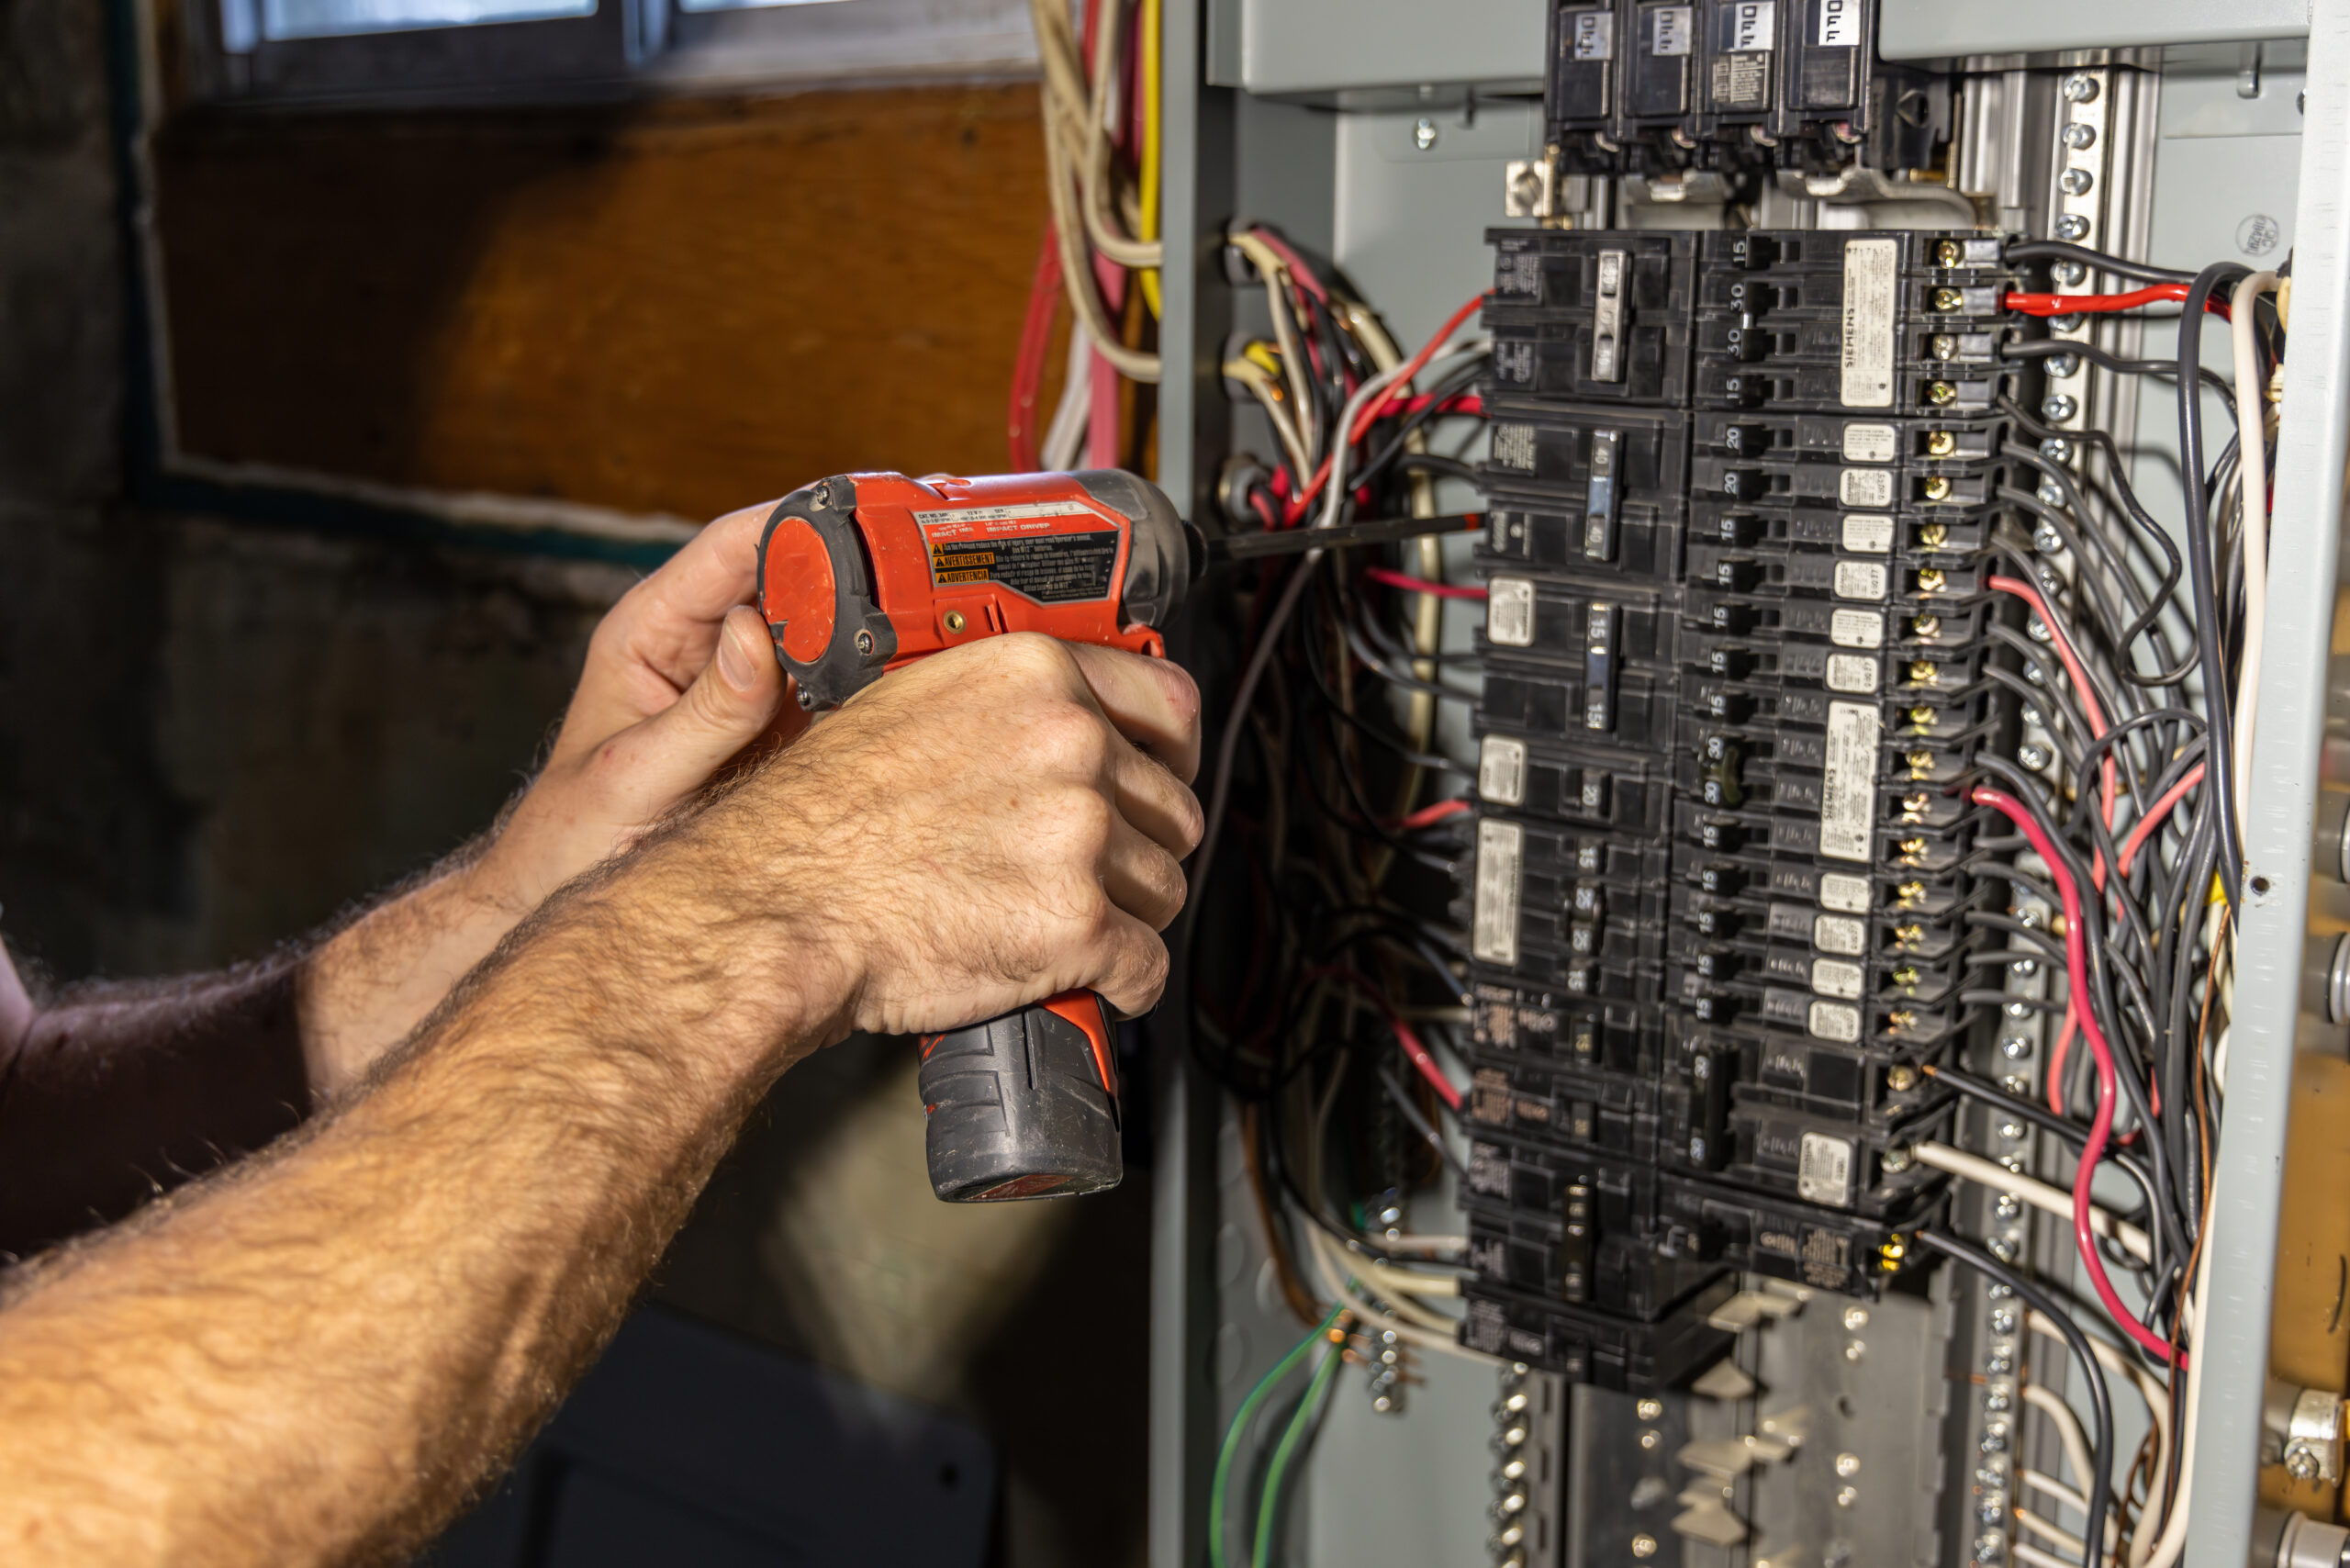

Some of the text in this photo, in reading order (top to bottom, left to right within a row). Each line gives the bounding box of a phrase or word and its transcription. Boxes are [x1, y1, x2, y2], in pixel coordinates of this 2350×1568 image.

[1659, 11, 1673, 50] OFF
[1741, 6, 1758, 48] OFF
[1826, 0, 1842, 42] OFF
[1732, 240, 1746, 263] 15
[1730, 283, 1744, 311] 30
[1727, 329, 1740, 357] 30
[1845, 308, 1855, 368] SIEMENS
[1727, 378, 1740, 400] 15
[1726, 427, 1740, 449] 20
[1724, 472, 1739, 495] 20
[986, 525, 1017, 533] IMPACT
[1020, 522, 1050, 531] DRIVER
[1720, 518, 1735, 540] 15
[945, 554, 993, 566] AVERTISSEMENT
[947, 570, 988, 583] ADVERTENCIA
[1718, 563, 1732, 585] 15
[1713, 606, 1728, 628] 15
[1591, 619, 1606, 638] 15
[1711, 652, 1726, 674] 15
[1711, 695, 1726, 717] 15
[1707, 736, 1723, 760] 30
[1582, 784, 1599, 806] 20
[1704, 781, 1720, 805] 30
[1825, 767, 1836, 820] SIEMENS
[1703, 826, 1718, 847] 15
[1579, 846, 1597, 868] 15
[1703, 870, 1718, 891] 15
[1575, 887, 1595, 910] 25
[1699, 912, 1714, 934] 15
[1572, 929, 1591, 952] 25
[1697, 954, 1713, 976] 15
[1568, 969, 1586, 991] 15
[1696, 998, 1712, 1020] 15
